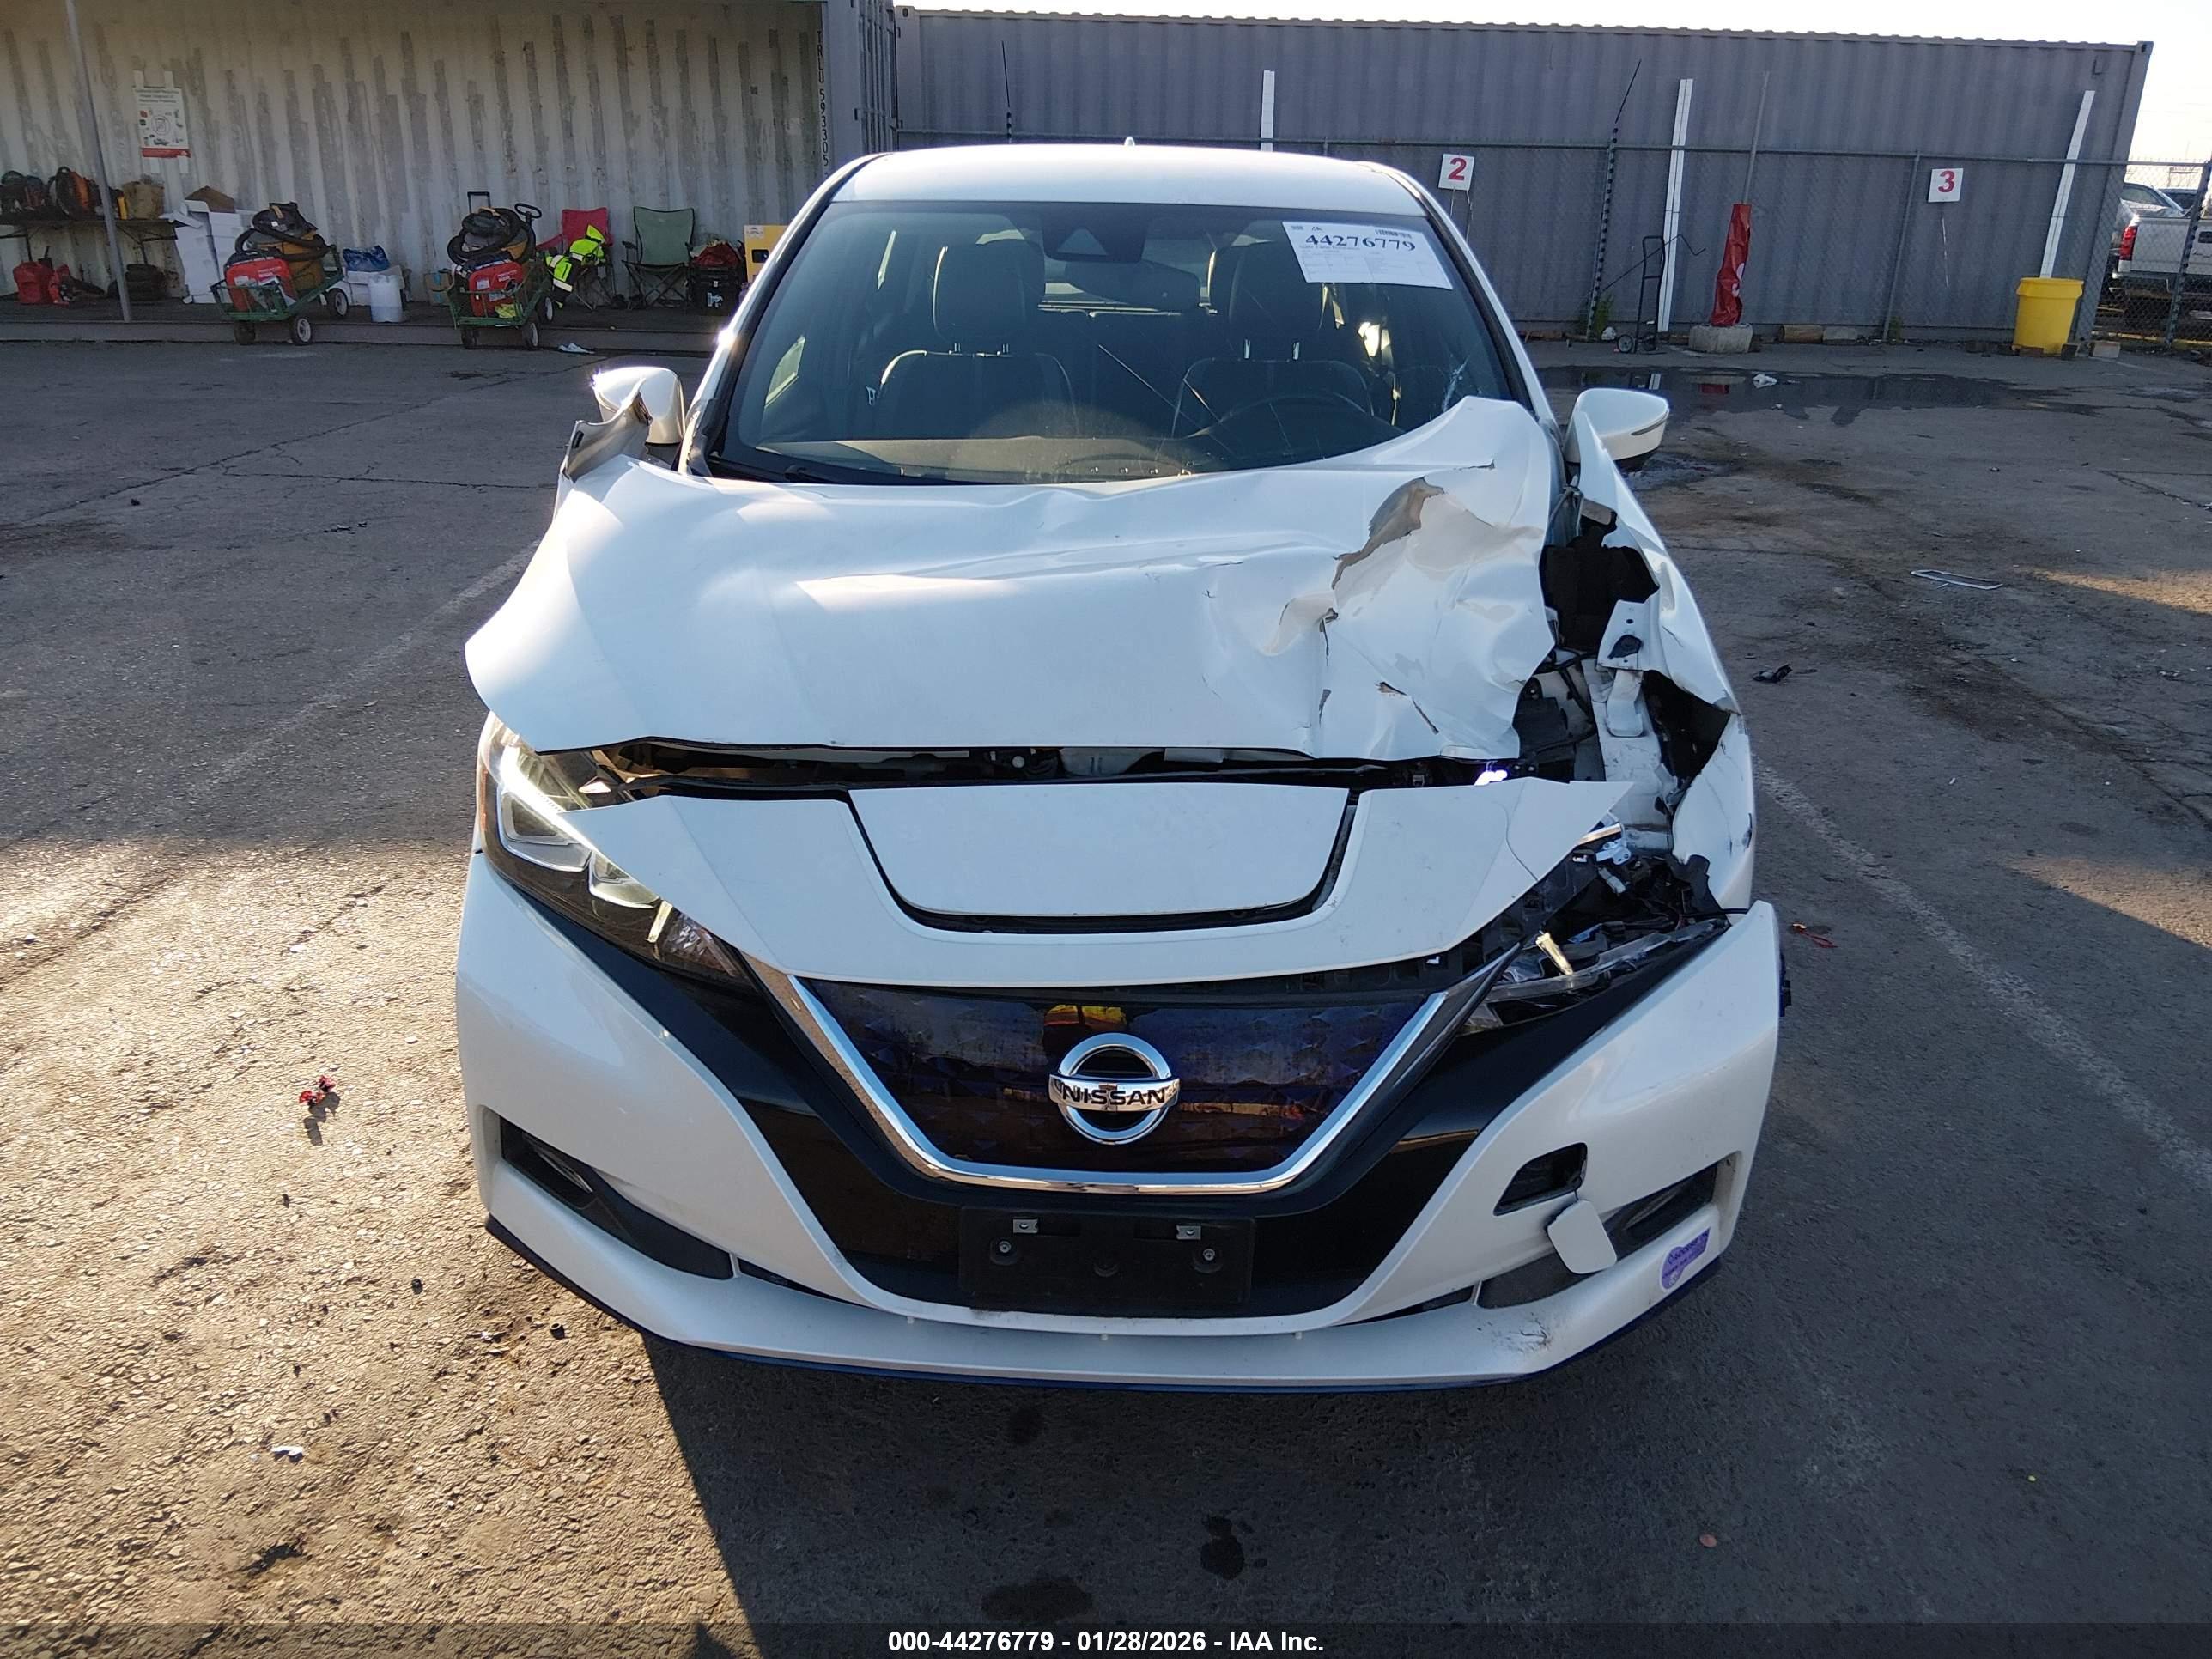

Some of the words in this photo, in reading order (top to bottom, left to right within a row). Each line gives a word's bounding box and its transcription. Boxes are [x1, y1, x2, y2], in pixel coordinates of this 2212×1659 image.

[819, 88, 829, 167] 593305
[1448, 157, 1467, 181] 2
[1937, 170, 1955, 193] 3
[1305, 234, 1416, 252] 44276779
[1062, 1083, 1166, 1105] NISSAN
